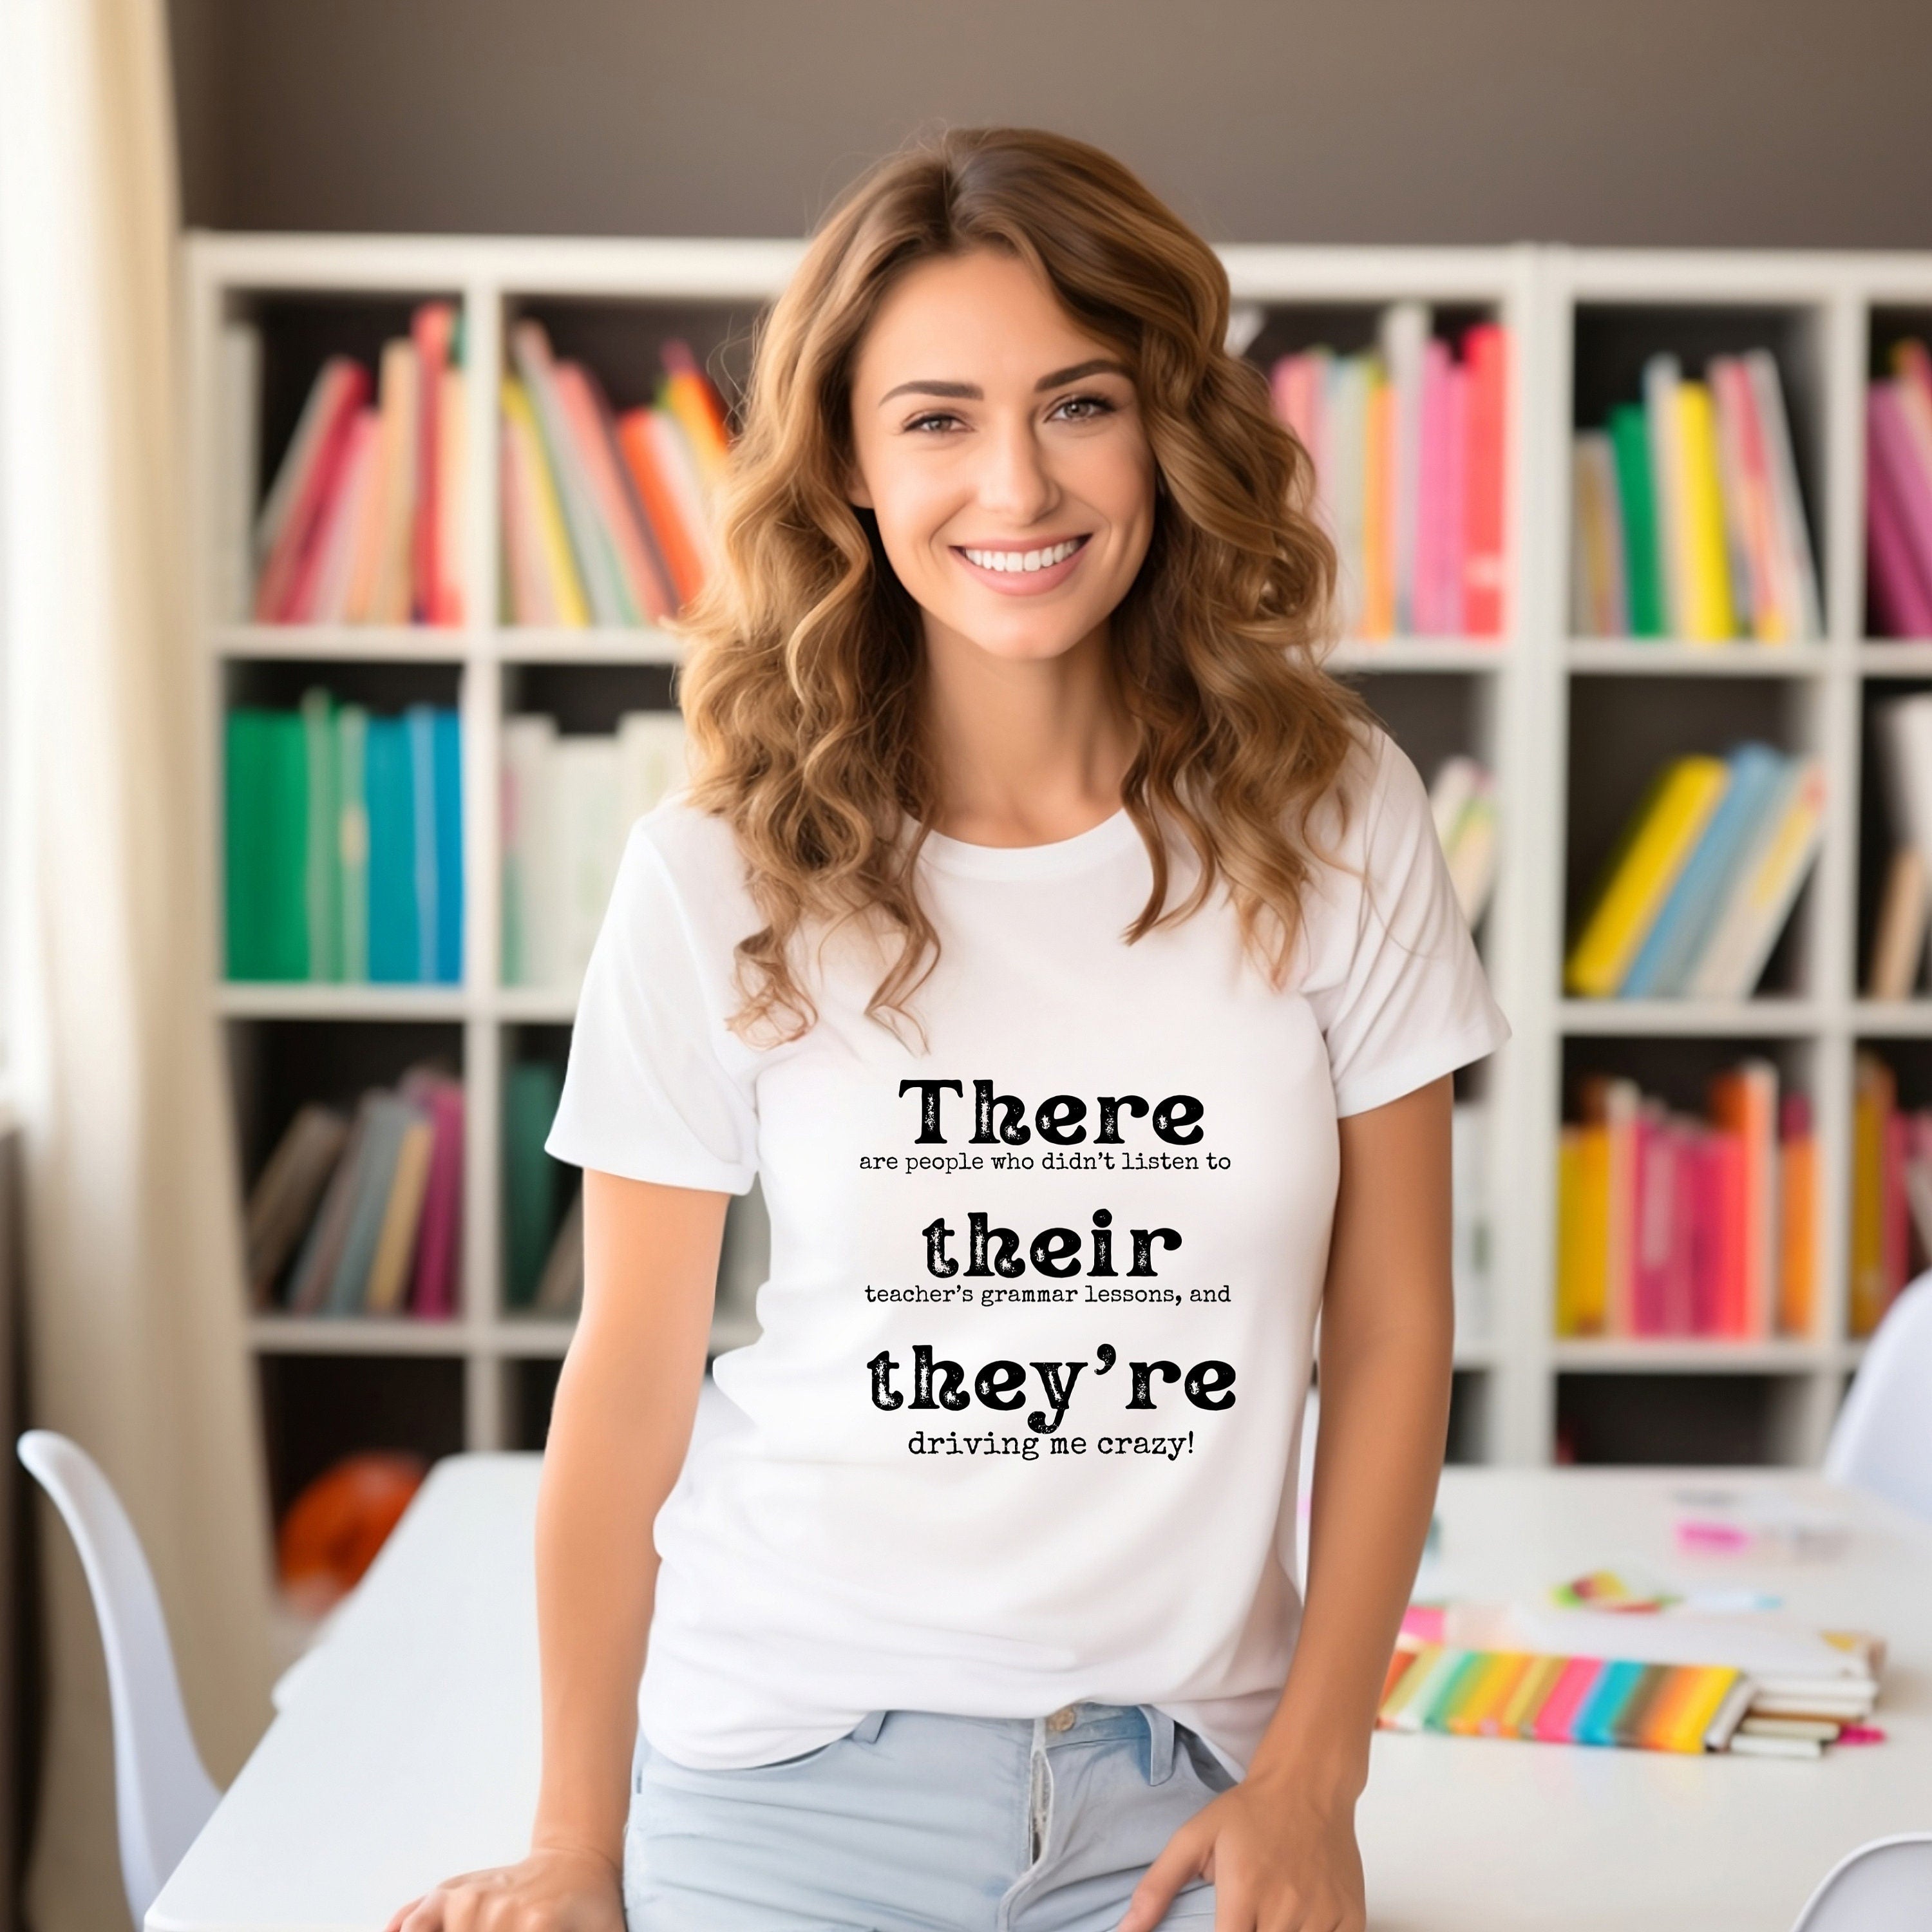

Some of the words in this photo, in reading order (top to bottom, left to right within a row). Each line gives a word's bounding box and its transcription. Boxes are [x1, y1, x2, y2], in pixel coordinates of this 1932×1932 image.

[898, 1079, 1204, 1146] There
[859, 1156, 898, 1170] are
[905, 1152, 983, 1175] people
[990, 1152, 1034, 1170] who
[1041, 1151, 1115, 1170] didn’t
[1122, 1152, 1199, 1170] listen
[1206, 1152, 1231, 1170] to
[922, 1208, 1183, 1279] their
[864, 1284, 974, 1303] teacher’s
[980, 1289, 1078, 1307] grammar
[1084, 1285, 1182, 1307] lessons,
[1189, 1285, 1231, 1303] and
[866, 1343, 1236, 1435] they’re
[908, 1430, 1039, 1461] driving
[1050, 1437, 1087, 1455] me
[1097, 1430, 1195, 1461] crazy!
